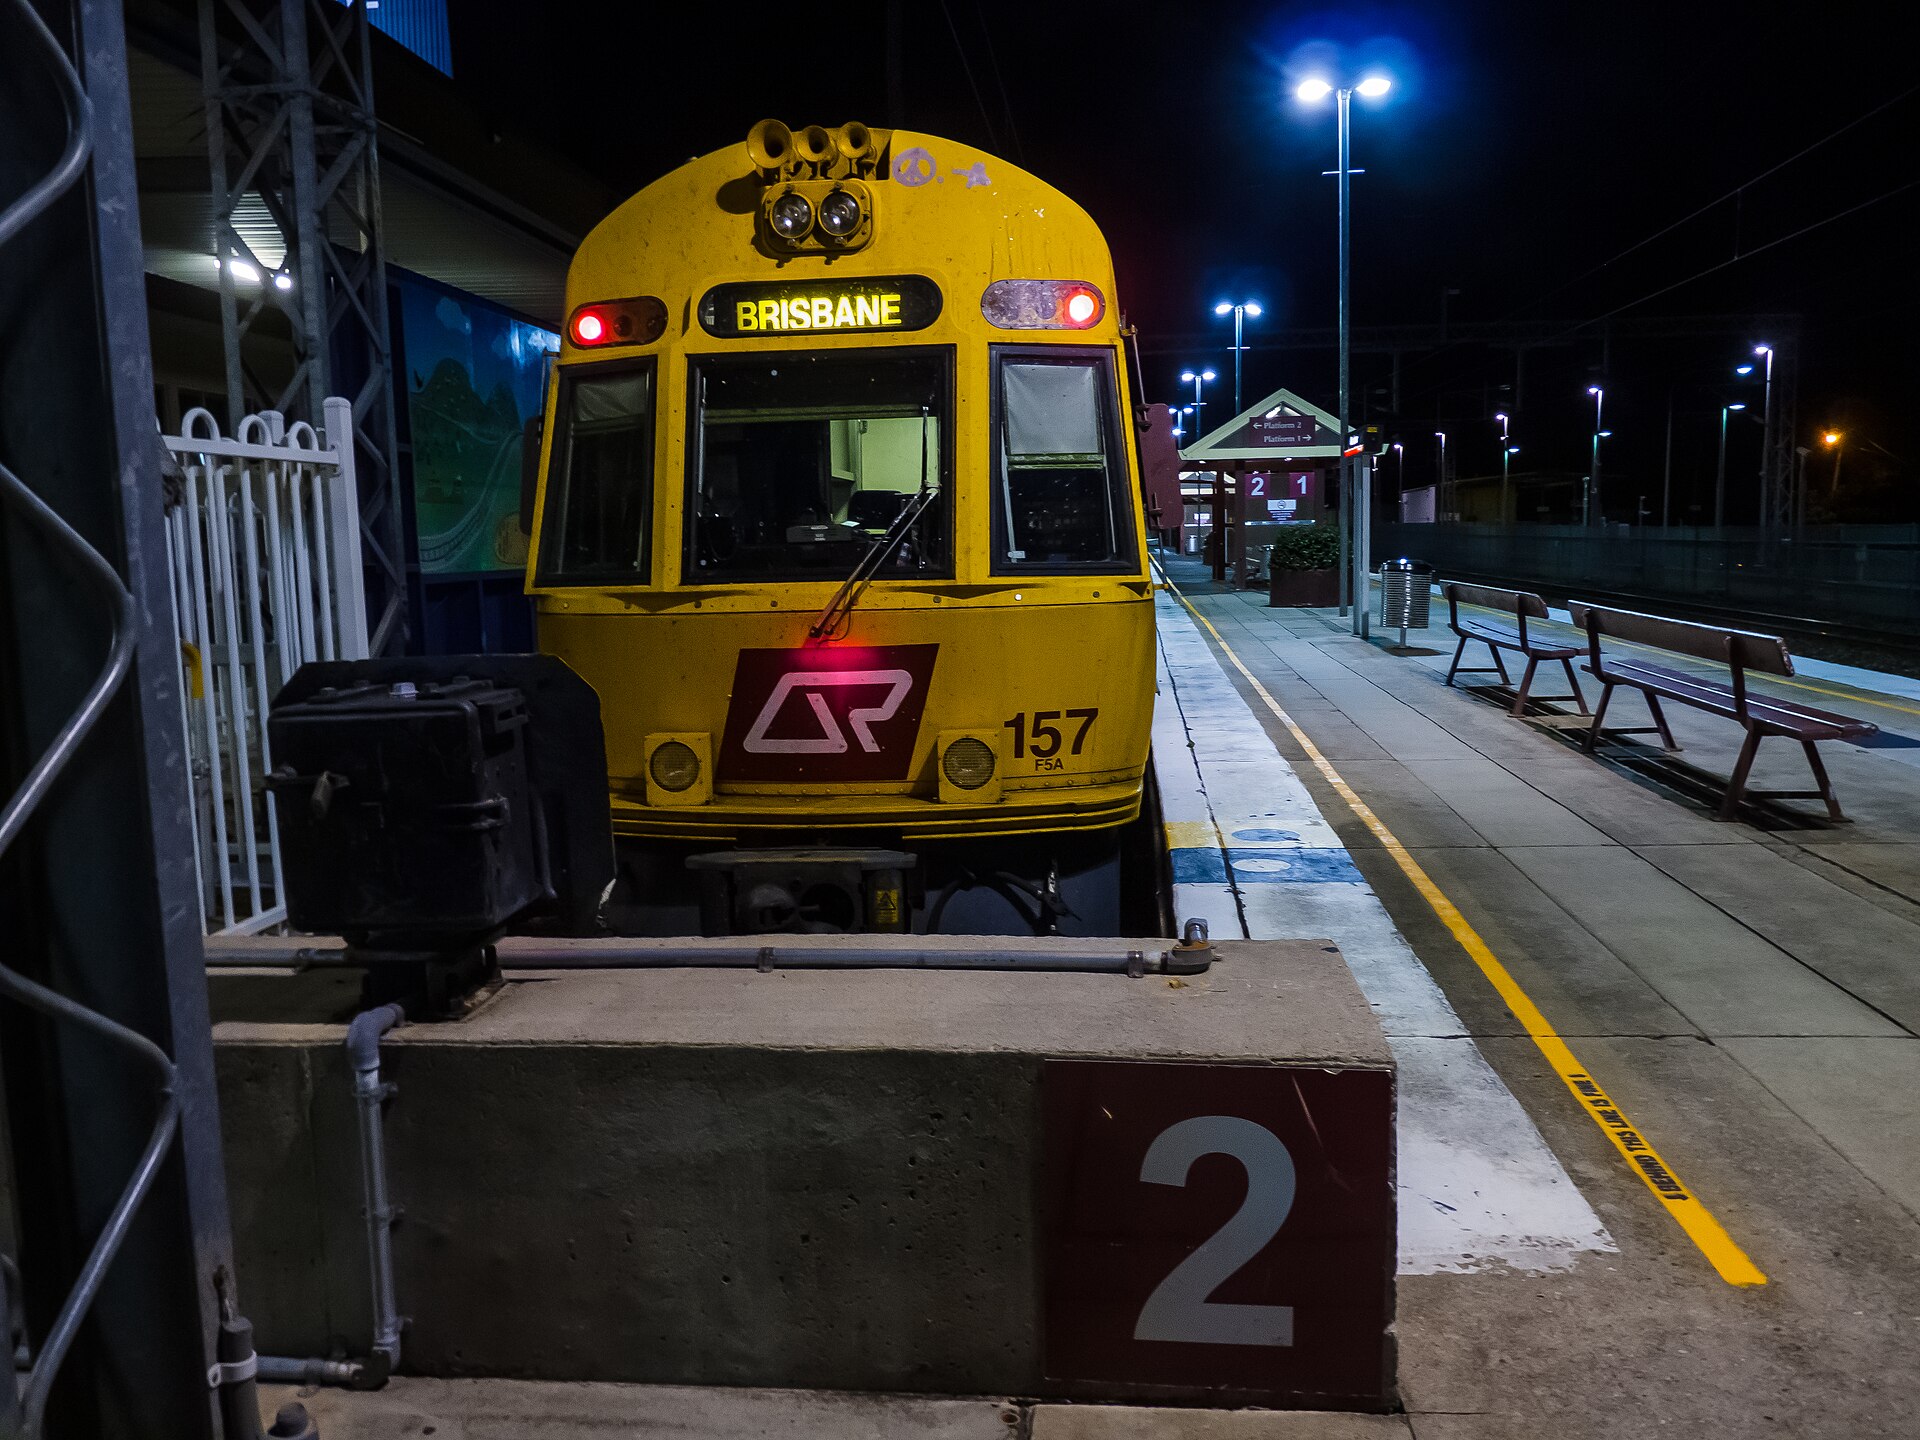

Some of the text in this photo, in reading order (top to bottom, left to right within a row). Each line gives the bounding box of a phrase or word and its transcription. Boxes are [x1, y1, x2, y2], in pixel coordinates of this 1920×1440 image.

[736, 294, 902, 331] BRISBANE
[1263, 421, 1302, 429] Platform 2
[1251, 477, 1264, 496] 2
[1297, 475, 1307, 495] 1
[1003, 708, 1099, 758] 157
[1034, 757, 1064, 771] F5A
[1588, 1098, 1612, 1107] IS
[1596, 1109, 1630, 1128] LINE
[1615, 1130, 1648, 1152] THIS
[1633, 1154, 1683, 1192] BEHIND
[1133, 1115, 1297, 1347] 2
